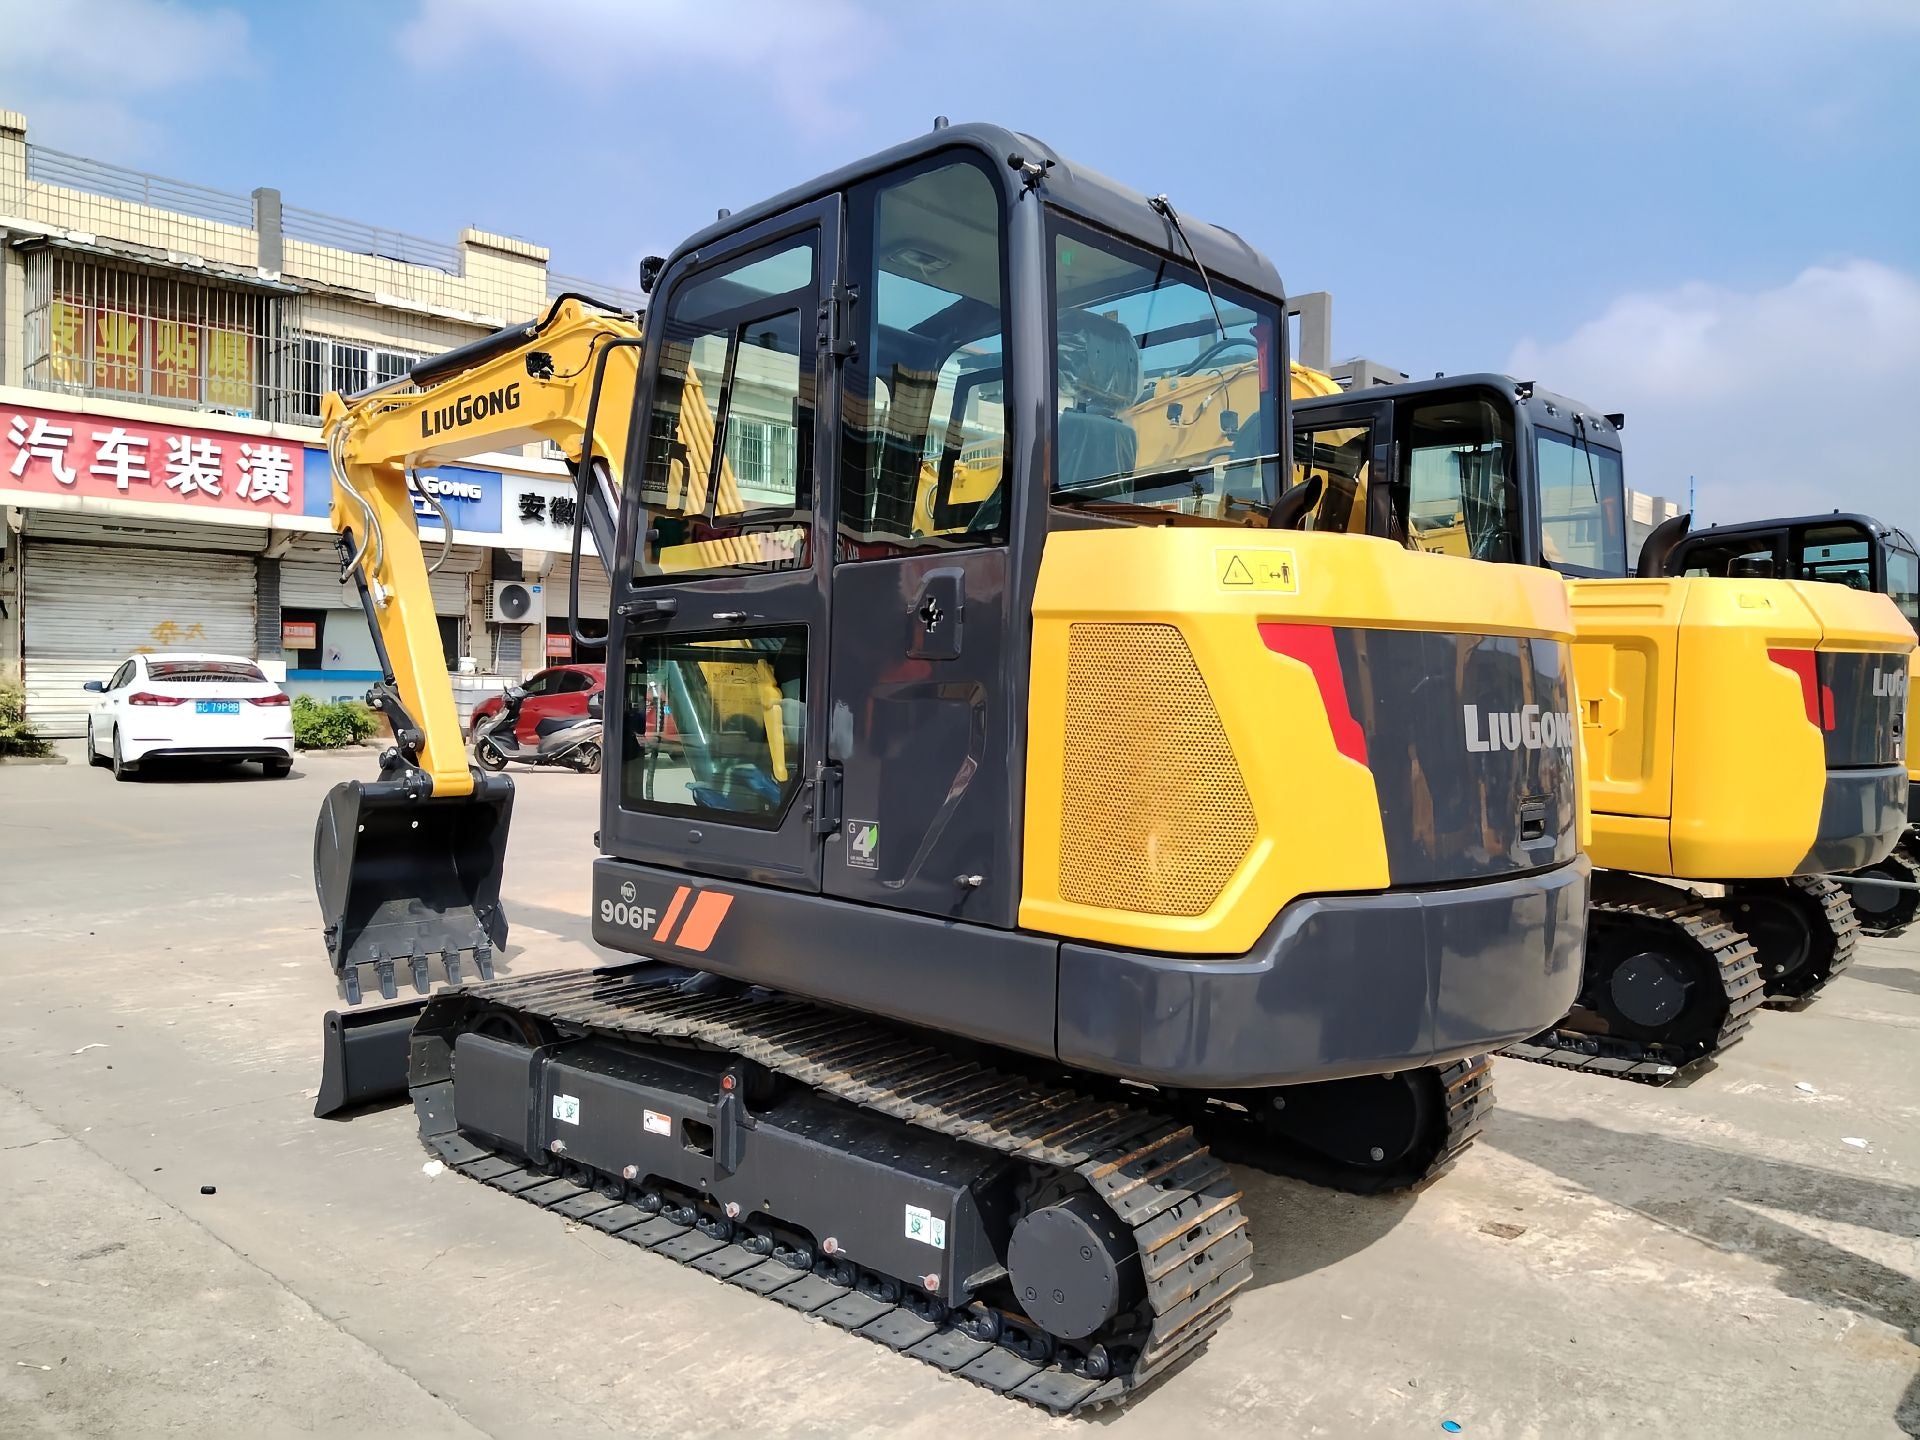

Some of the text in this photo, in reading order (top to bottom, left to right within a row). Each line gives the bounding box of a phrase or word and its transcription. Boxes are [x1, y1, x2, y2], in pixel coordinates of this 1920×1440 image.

[7, 414, 295, 506] 汽车装潢
[848, 822, 856, 834] G
[852, 826, 873, 858] 4
[600, 898, 657, 931] 906F
